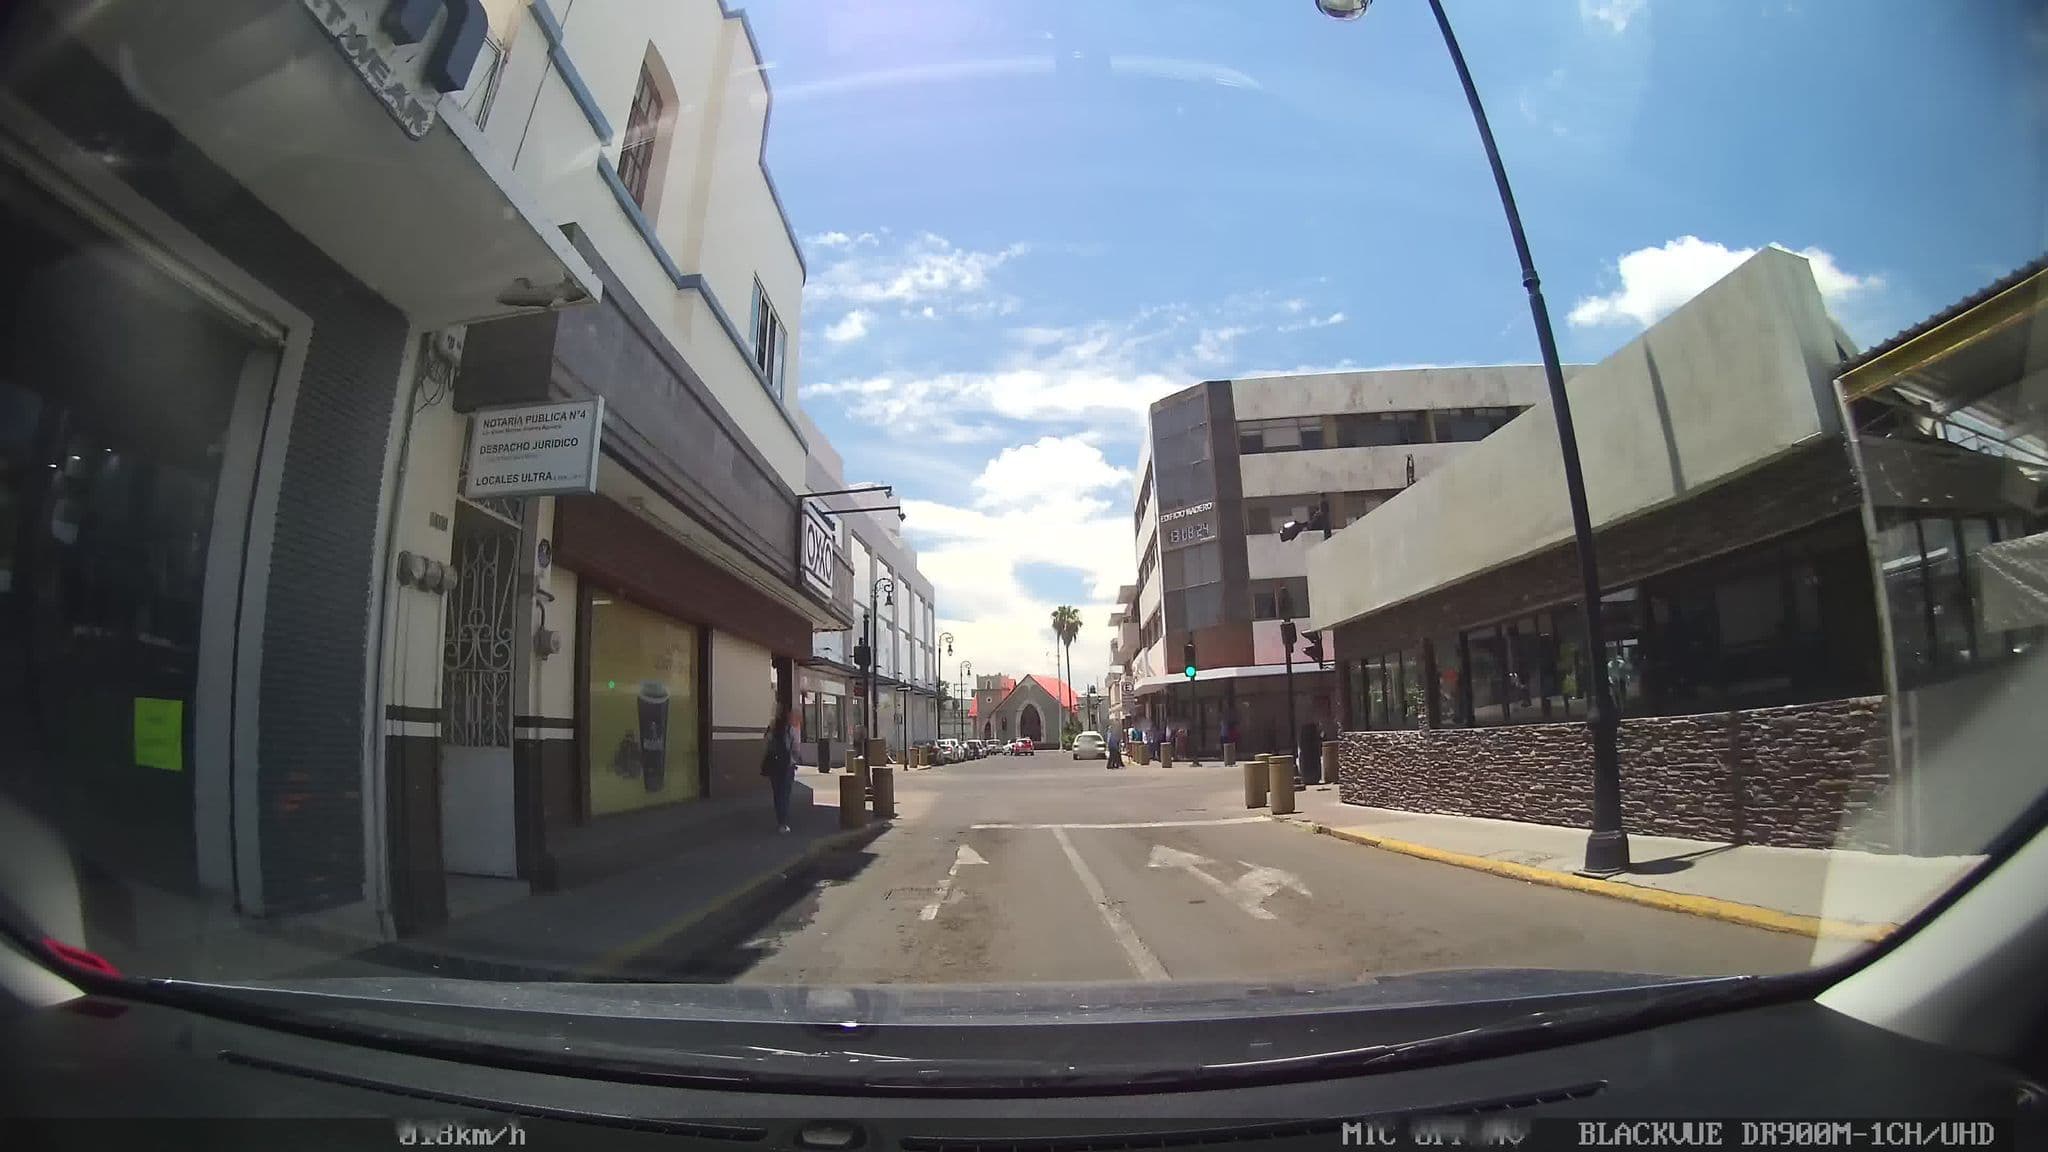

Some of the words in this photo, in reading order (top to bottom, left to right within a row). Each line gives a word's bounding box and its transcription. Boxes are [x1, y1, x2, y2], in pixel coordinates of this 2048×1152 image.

[483, 416, 523, 429] NOTARIA
[525, 412, 567, 425] PUBLICA
[480, 442, 531, 455] DESPACHO
[532, 437, 578, 450] JURIDICO
[476, 475, 520, 487] LOCALES
[521, 471, 553, 483] ULTRA
[1185, 502, 1213, 515] MADERO
[807, 524, 832, 581] OXXO
